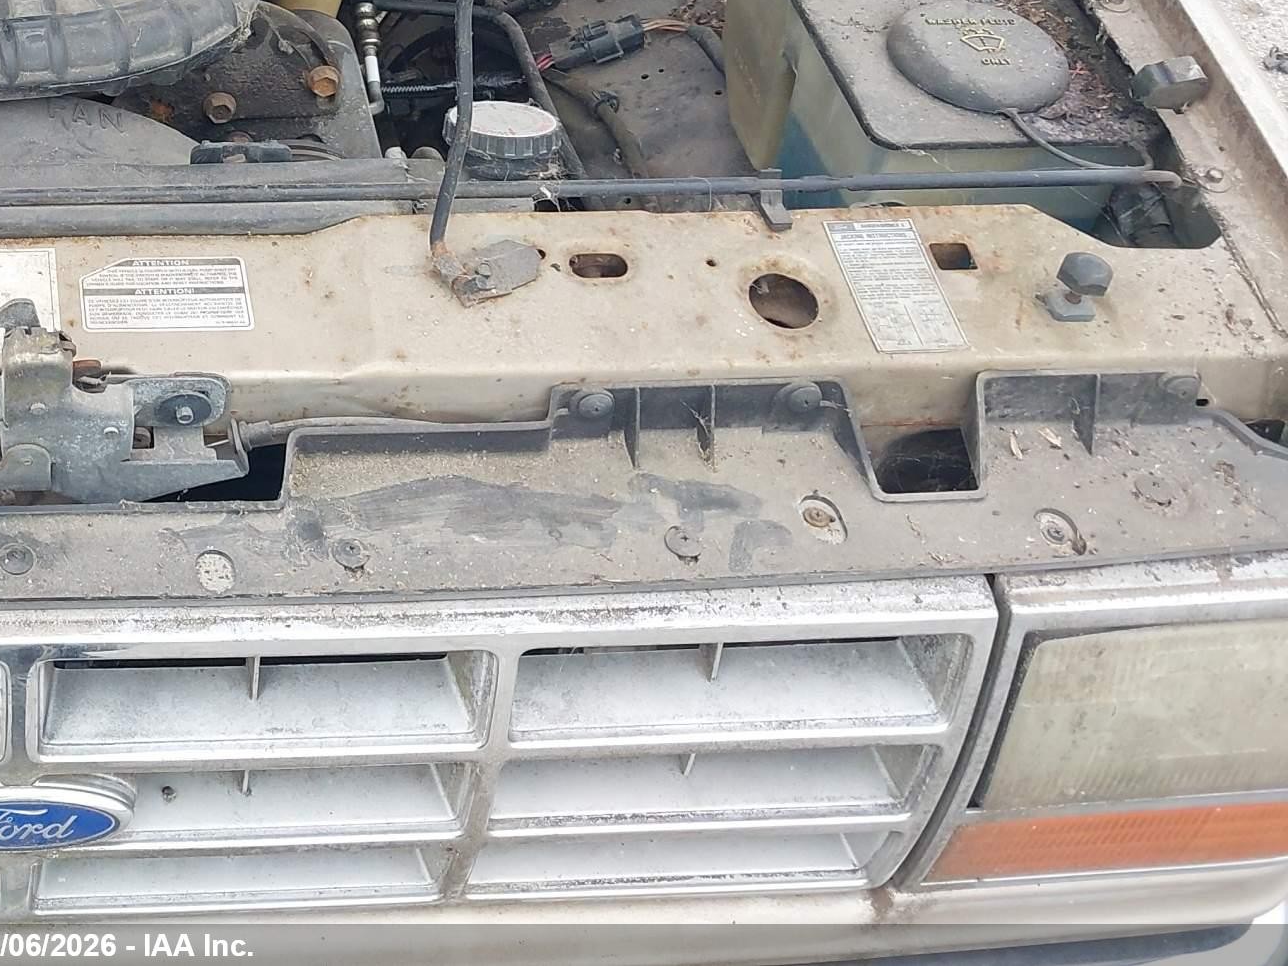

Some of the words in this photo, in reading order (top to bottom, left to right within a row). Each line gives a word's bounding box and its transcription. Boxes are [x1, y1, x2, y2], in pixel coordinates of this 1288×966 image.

[925, 18, 977, 26] WASHER
[980, 18, 1016, 26] FLUID
[981, 57, 1011, 66] ONLY
[134, 287, 195, 296] ATTENTION!
